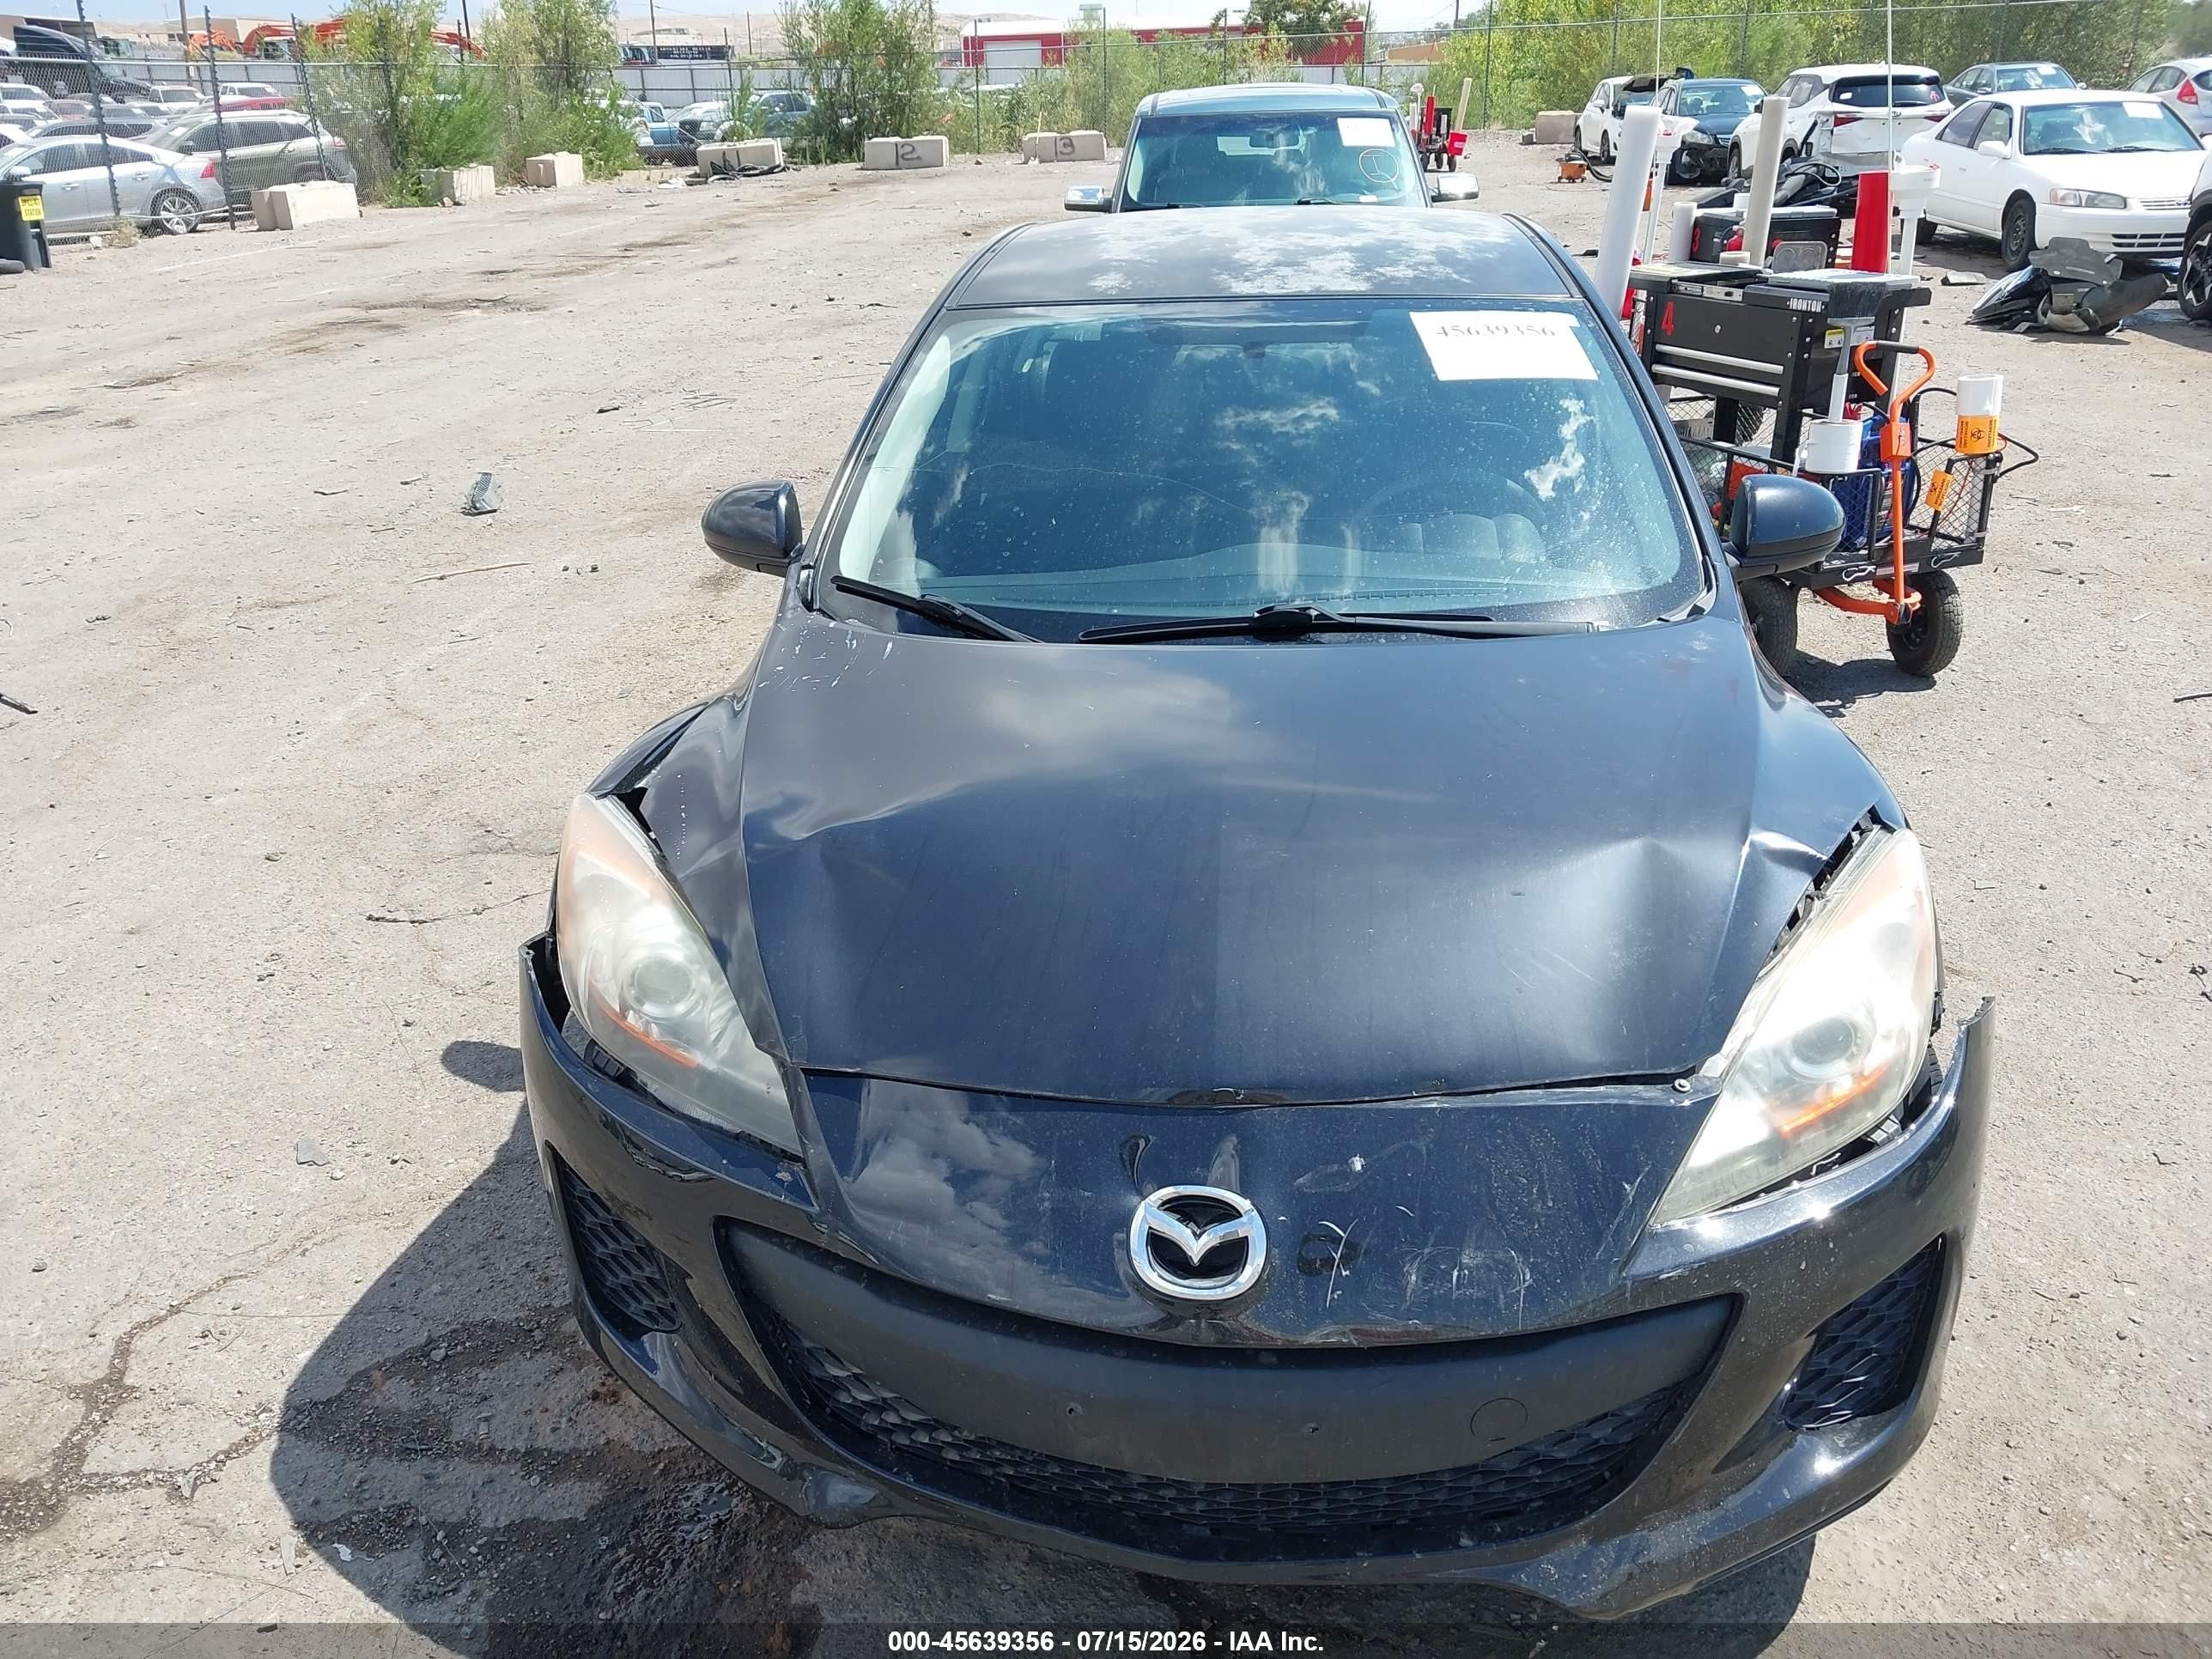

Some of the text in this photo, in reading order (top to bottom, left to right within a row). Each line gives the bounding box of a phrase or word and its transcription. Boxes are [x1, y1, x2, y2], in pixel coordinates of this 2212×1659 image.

[894, 143, 922, 166] 12
[1054, 137, 1075, 158] 13
[1692, 227, 1700, 252] 3
[1789, 297, 1822, 312] IRONTON
[1662, 301, 1674, 336] 4
